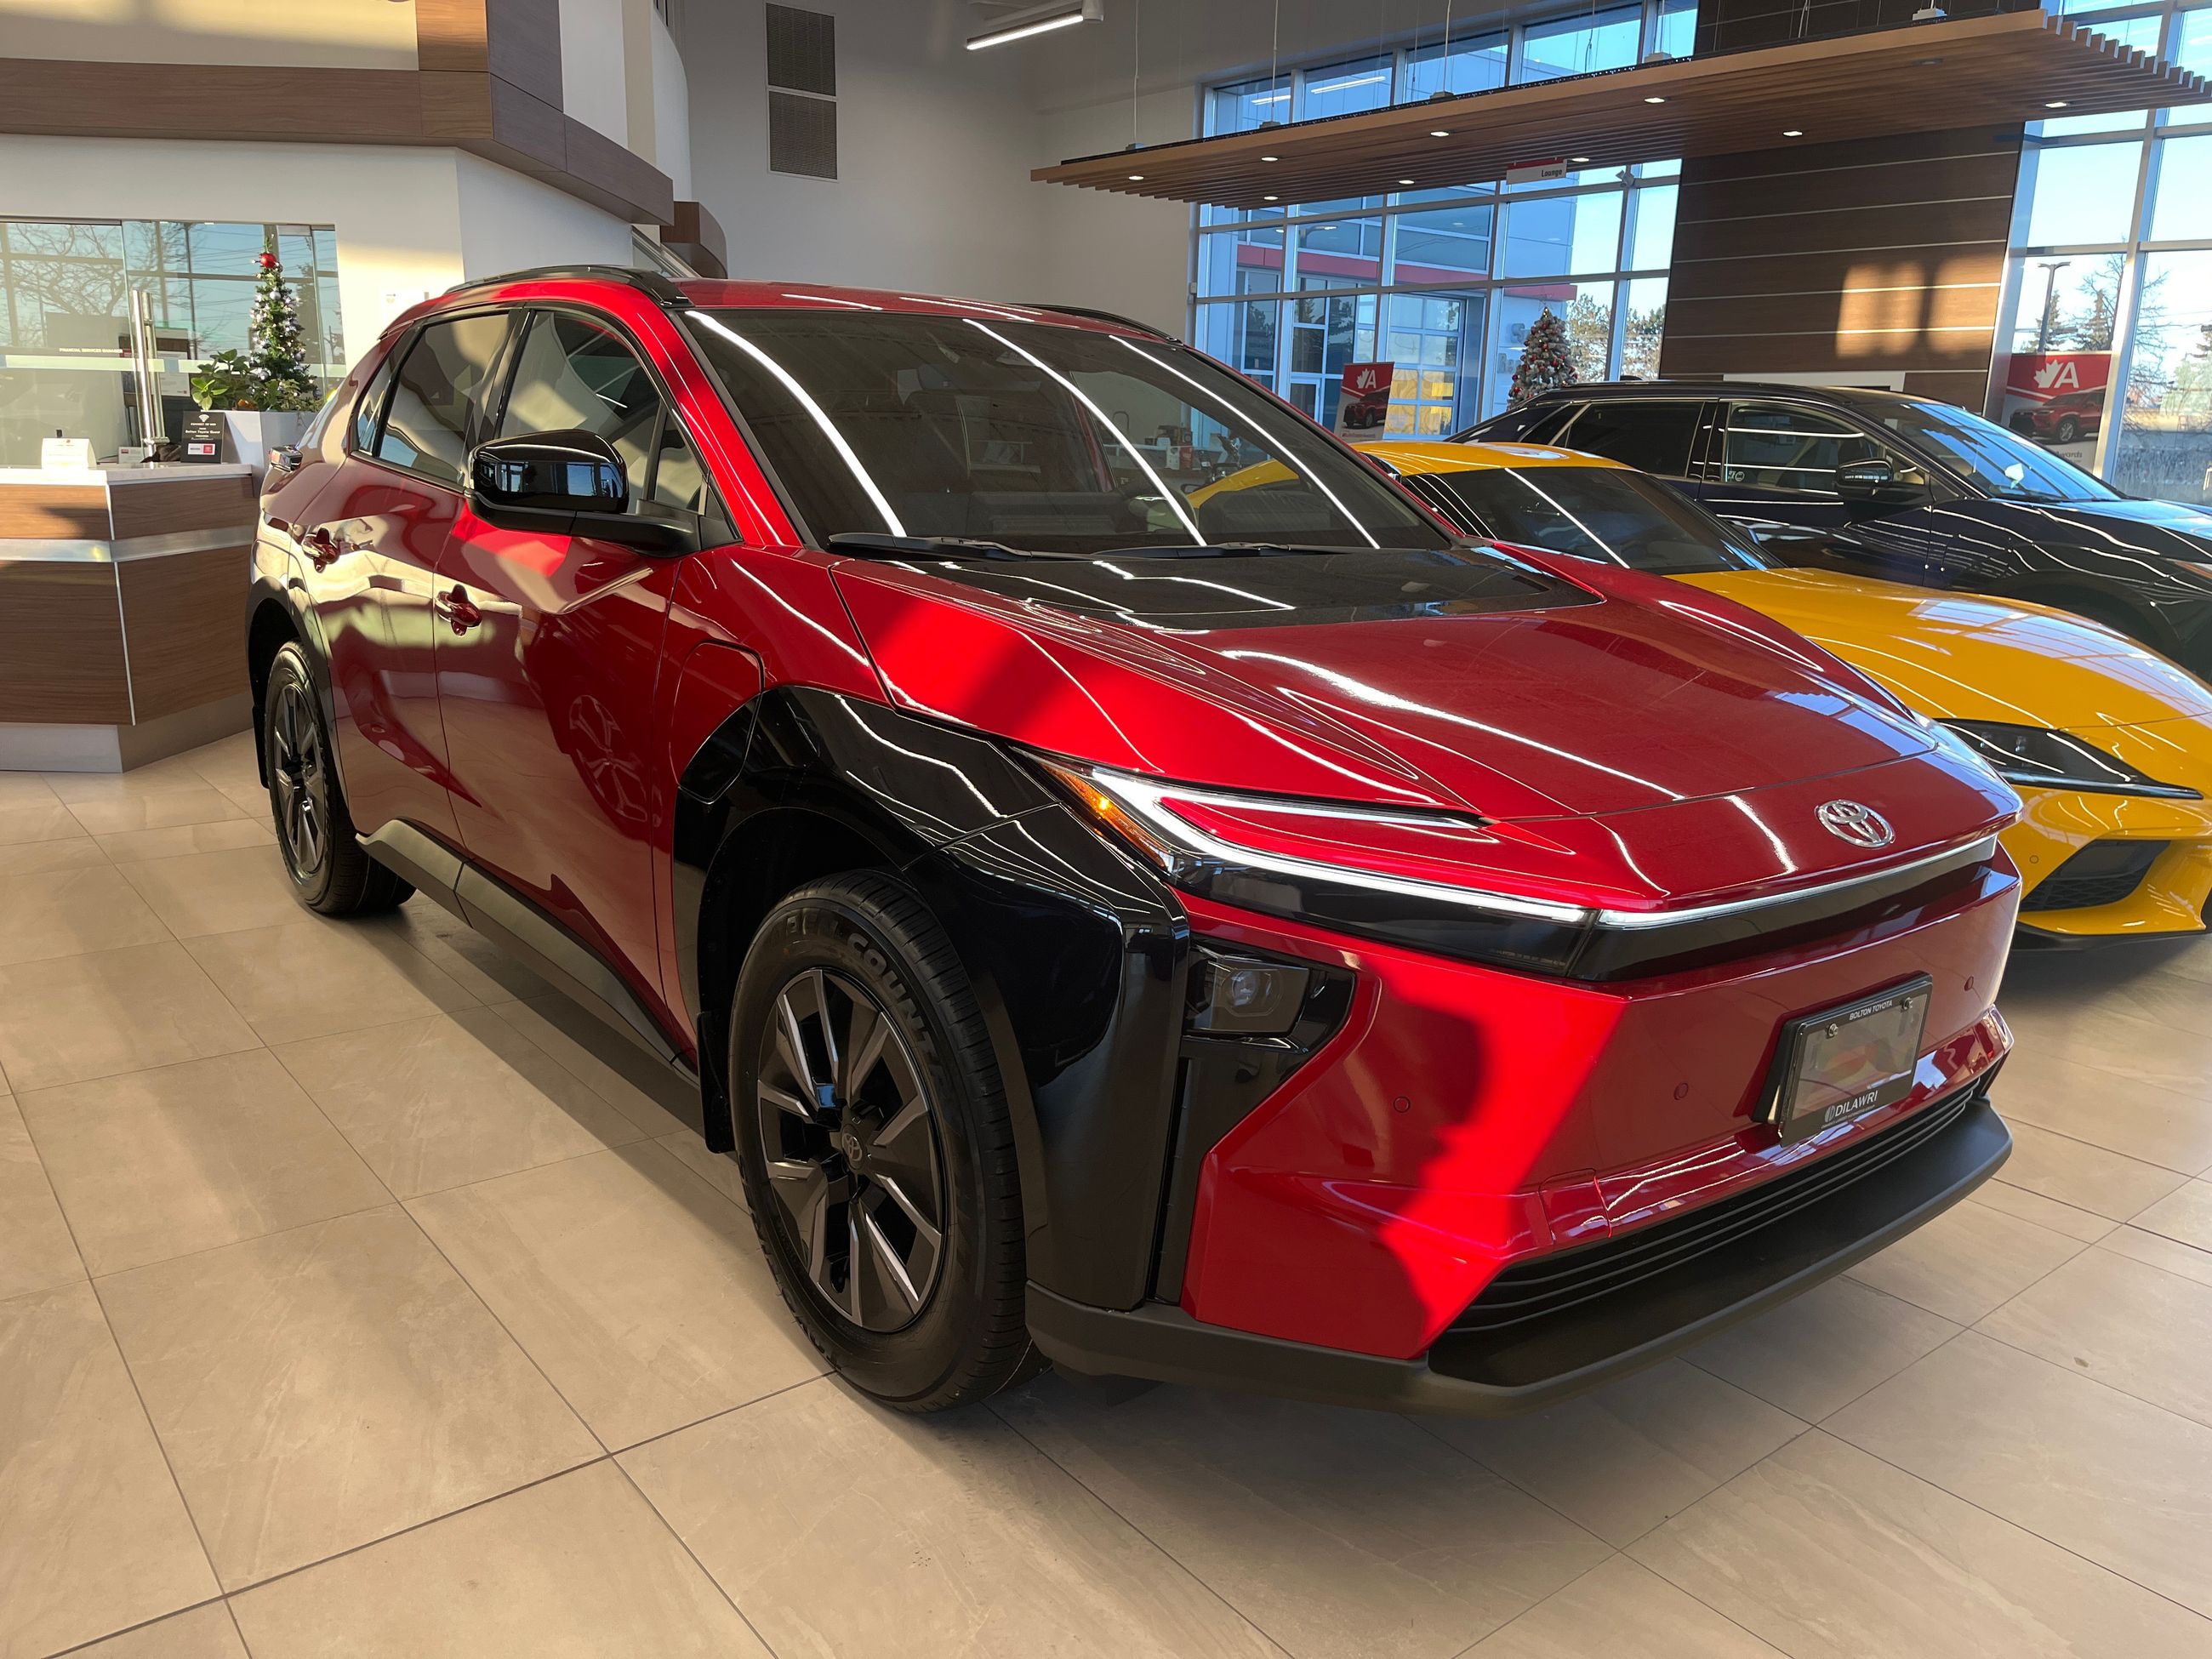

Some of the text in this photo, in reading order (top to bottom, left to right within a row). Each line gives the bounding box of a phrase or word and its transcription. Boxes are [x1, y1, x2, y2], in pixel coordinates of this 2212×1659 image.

[1541, 169, 1563, 178] Lounge
[1849, 1000, 1893, 1021] BOLTON TOYOTA
[1834, 1090, 1878, 1117] DILAWRI
